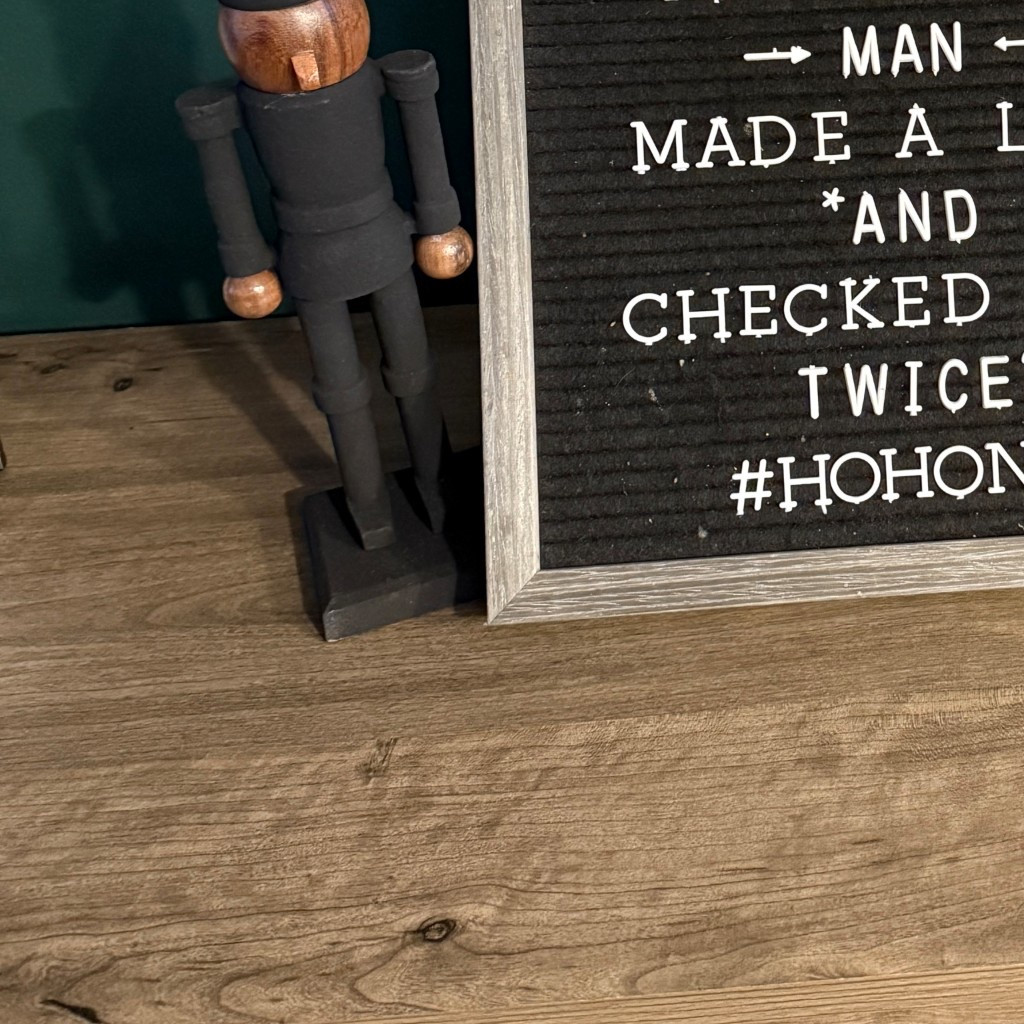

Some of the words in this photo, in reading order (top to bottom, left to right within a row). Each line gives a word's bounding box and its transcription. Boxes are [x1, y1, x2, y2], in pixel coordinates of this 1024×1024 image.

[842, 22, 963, 79] MAN
[630, 110, 851, 175] MADE
[895, 102, 945, 159] A
[622, 272, 990, 346] CHECKED
